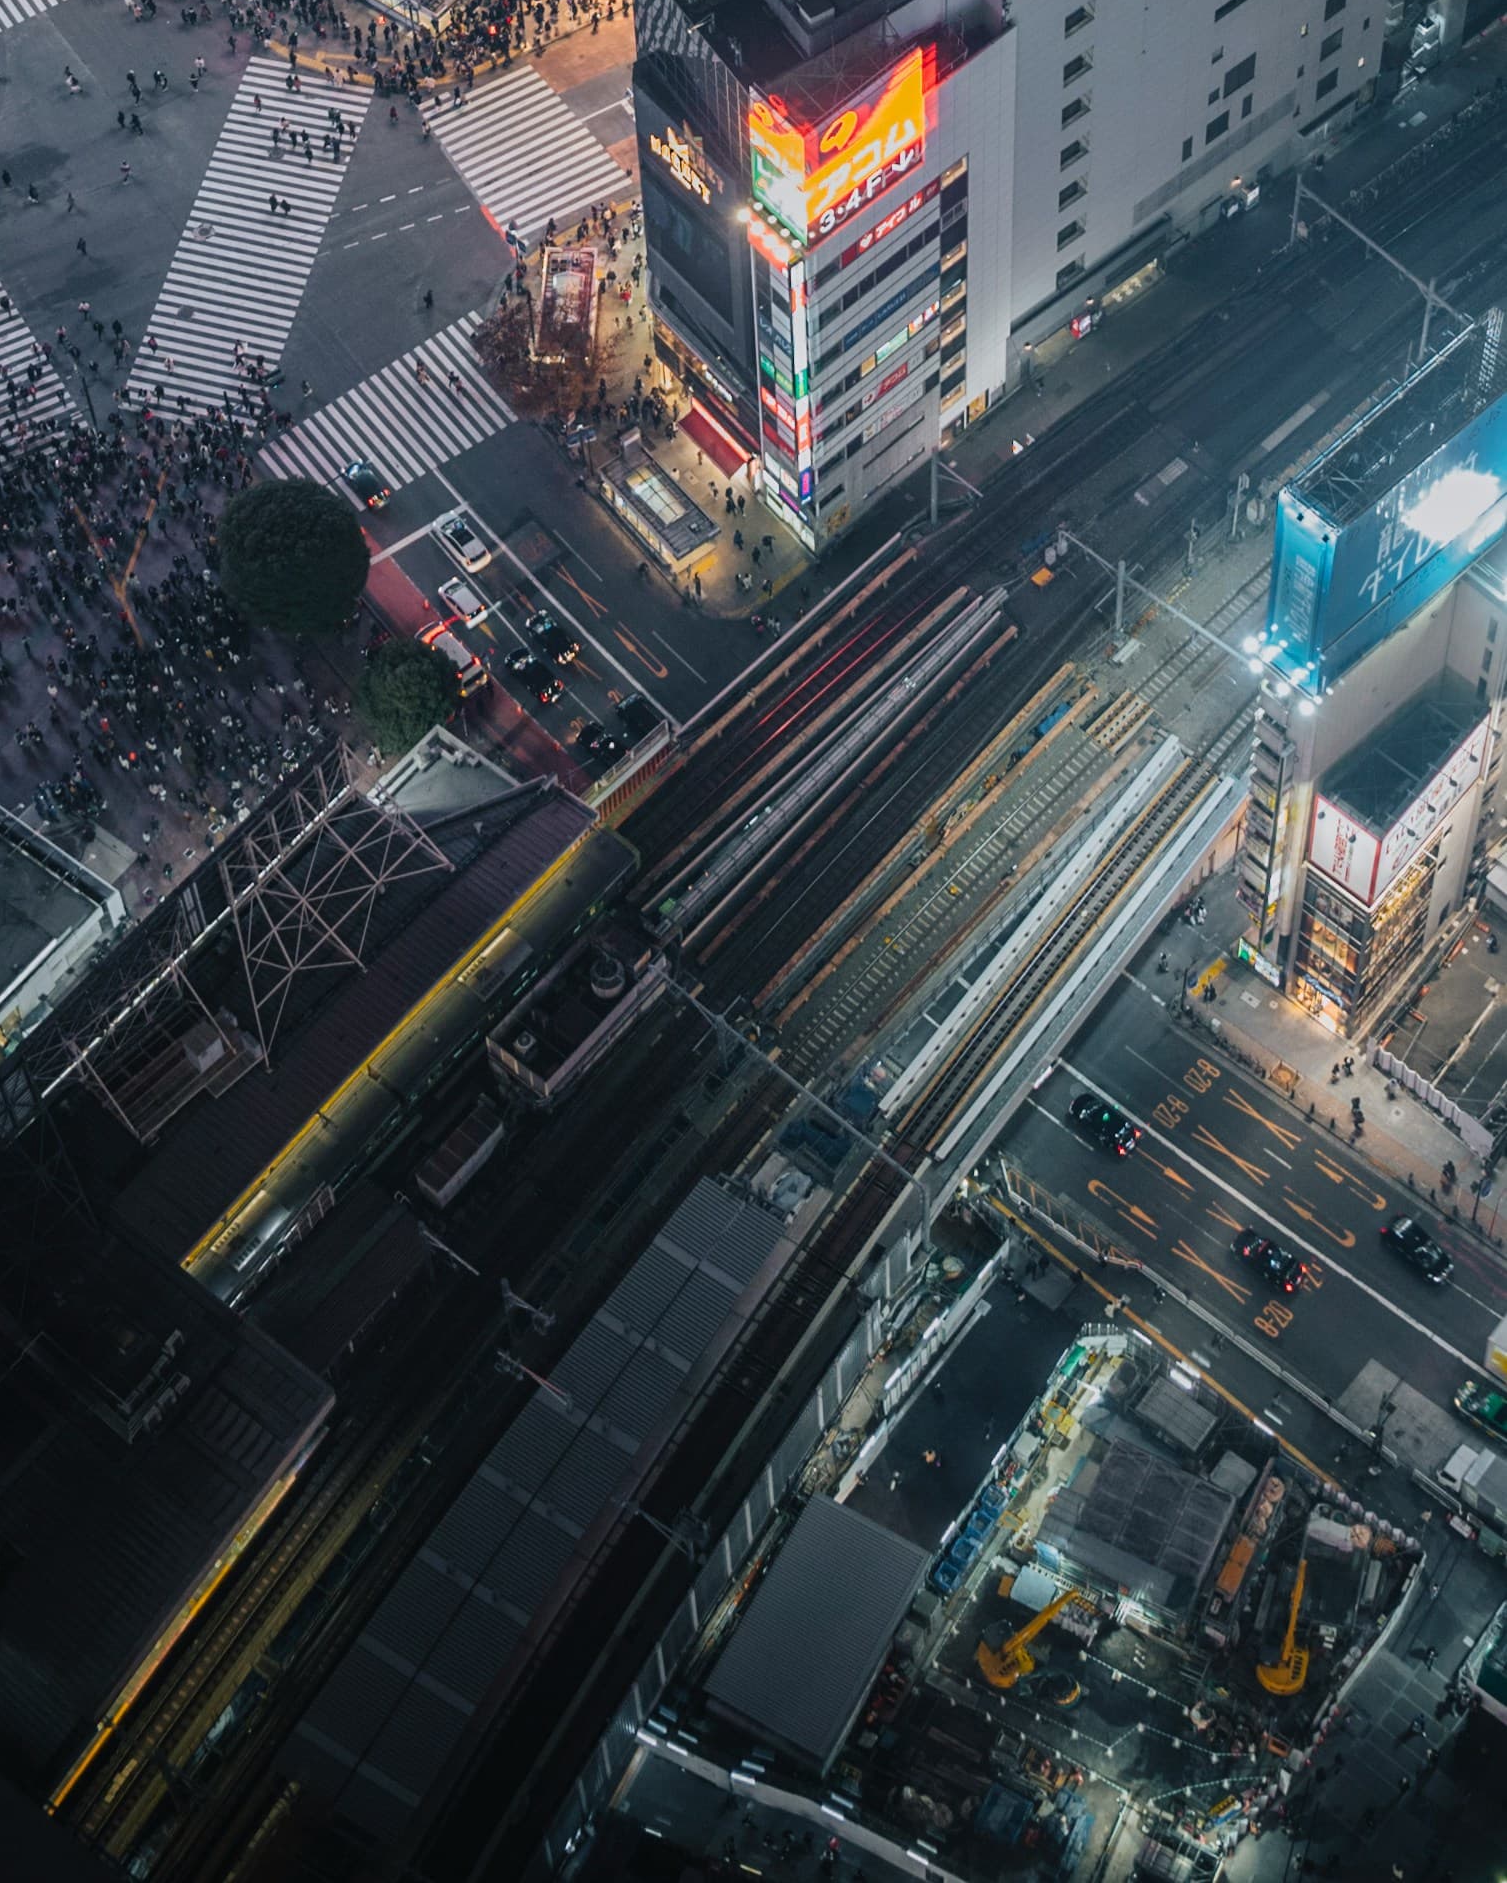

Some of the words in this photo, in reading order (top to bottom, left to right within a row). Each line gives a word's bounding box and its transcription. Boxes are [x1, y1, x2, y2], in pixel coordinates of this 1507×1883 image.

[813, 119, 917, 218] アコム
[1253, 1299, 1294, 1338] 8-20
